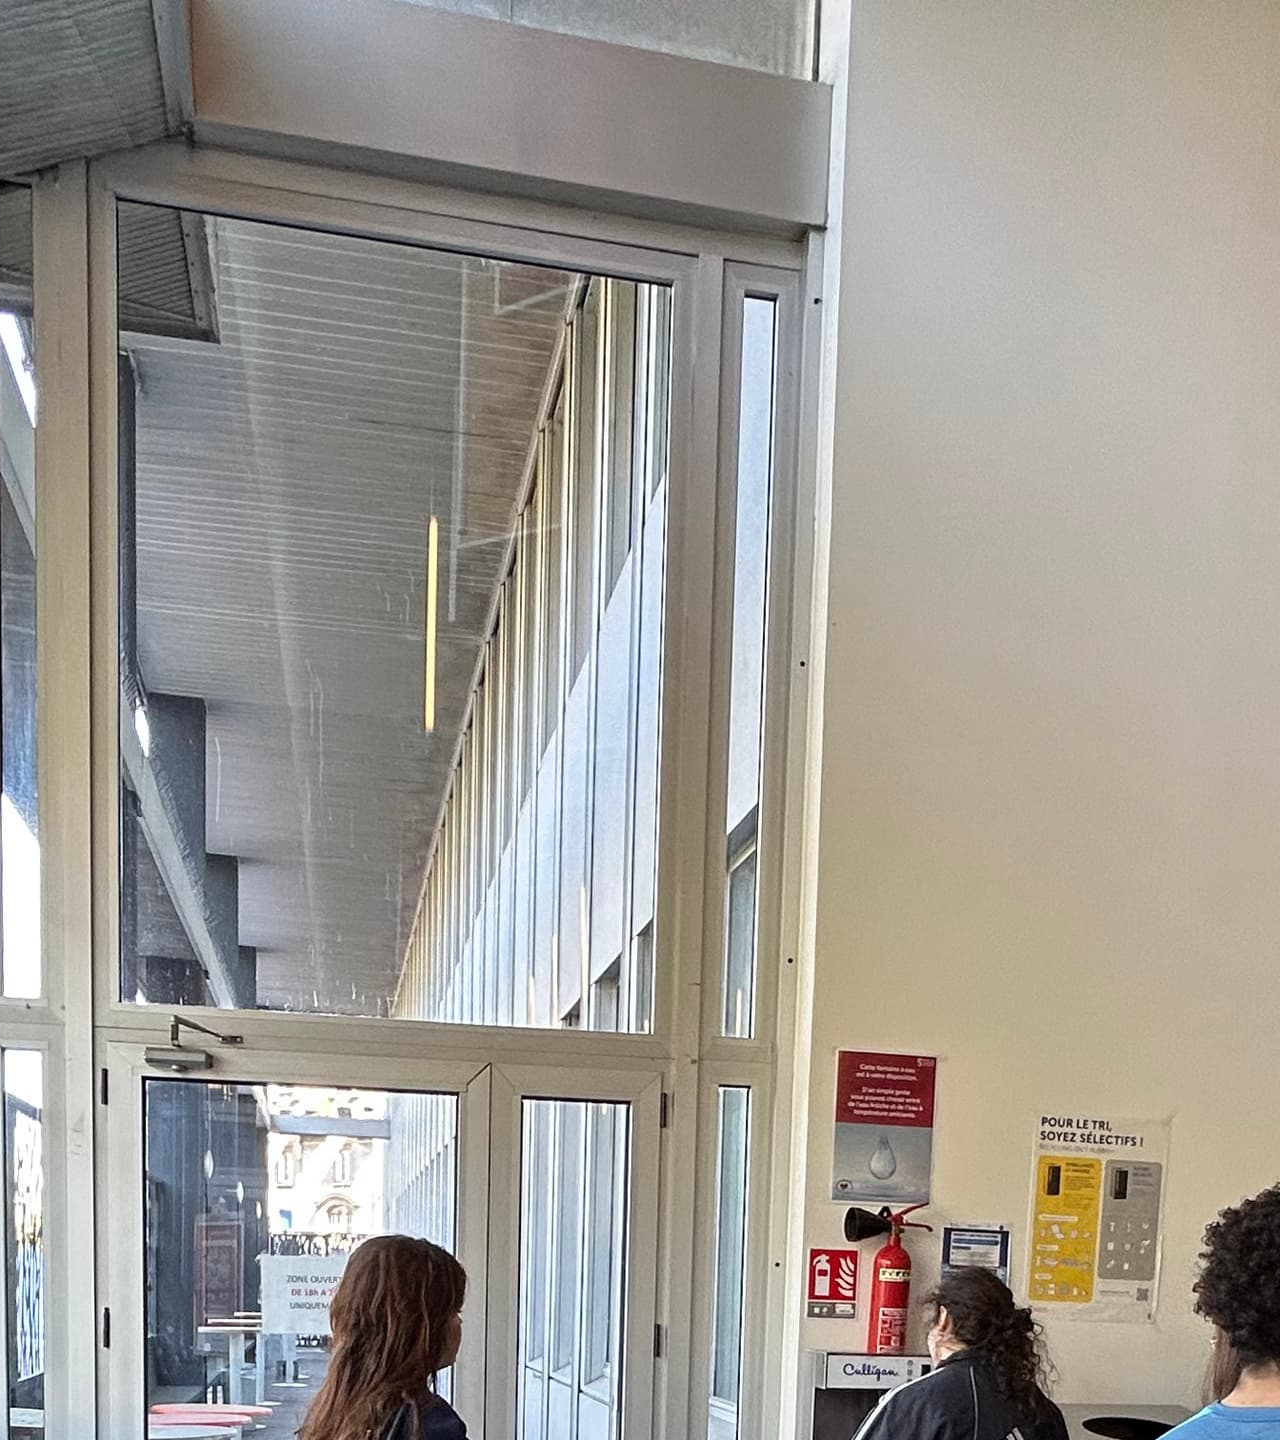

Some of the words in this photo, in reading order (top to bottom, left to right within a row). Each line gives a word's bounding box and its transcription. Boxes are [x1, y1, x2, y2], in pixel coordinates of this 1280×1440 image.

[1041, 1116, 1074, 1128] POUR
[1076, 1119, 1089, 1130] LE
[1091, 1120, 1113, 1132] TRI,
[1040, 1130, 1076, 1143] SOYEZ
[1079, 1132, 1137, 1147] SÉLECTIFS
[286, 1275, 308, 1284] ZONE
[291, 1288, 301, 1296] DE
[843, 1363, 896, 1381] Culligan
